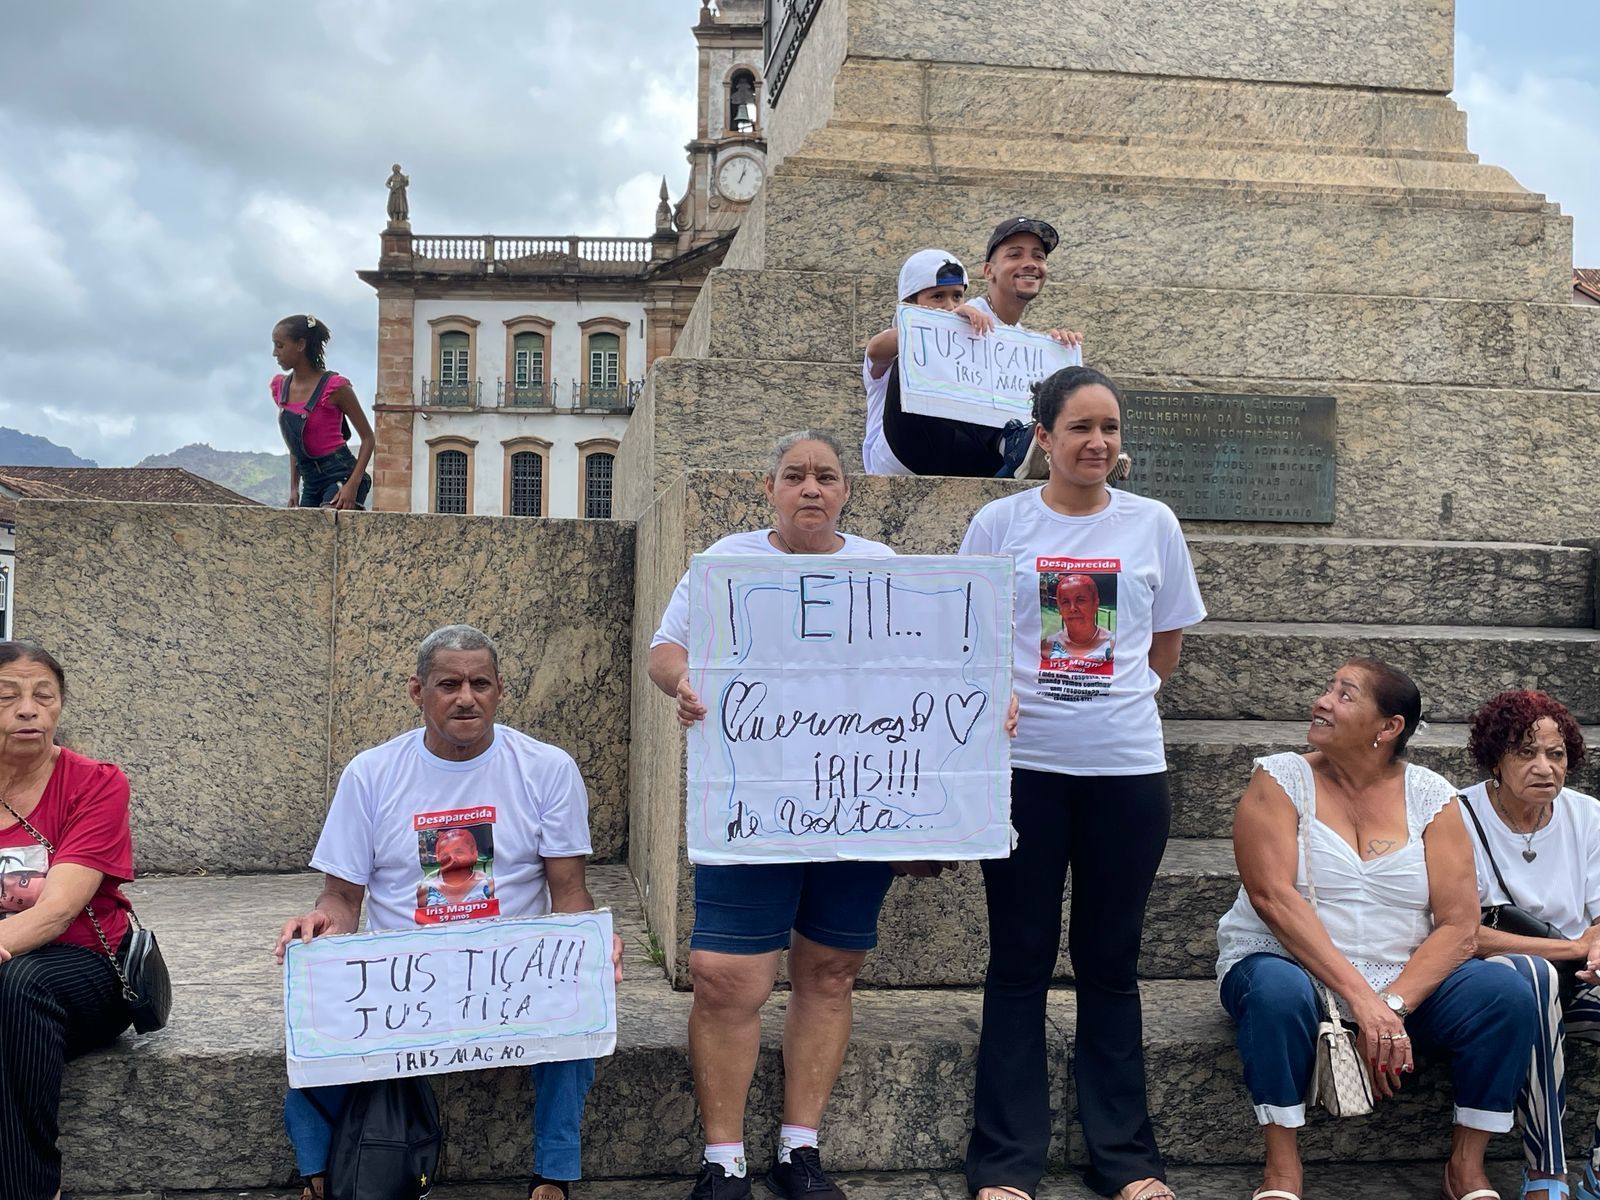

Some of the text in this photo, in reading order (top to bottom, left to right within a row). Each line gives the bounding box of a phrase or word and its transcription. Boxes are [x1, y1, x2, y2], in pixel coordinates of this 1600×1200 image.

[995, 375, 1033, 393] MAG
[1135, 396, 1186, 408] POETISA
[1126, 408, 1301, 426] GUILHERMINA DA SILVEIRA
[1185, 427, 1200, 438] DA
[1040, 559, 1116, 570] Desaparecida
[417, 809, 493, 826] Desaparecida
[426, 903, 488, 916] Iris Magno
[439, 914, 449, 922] 59
